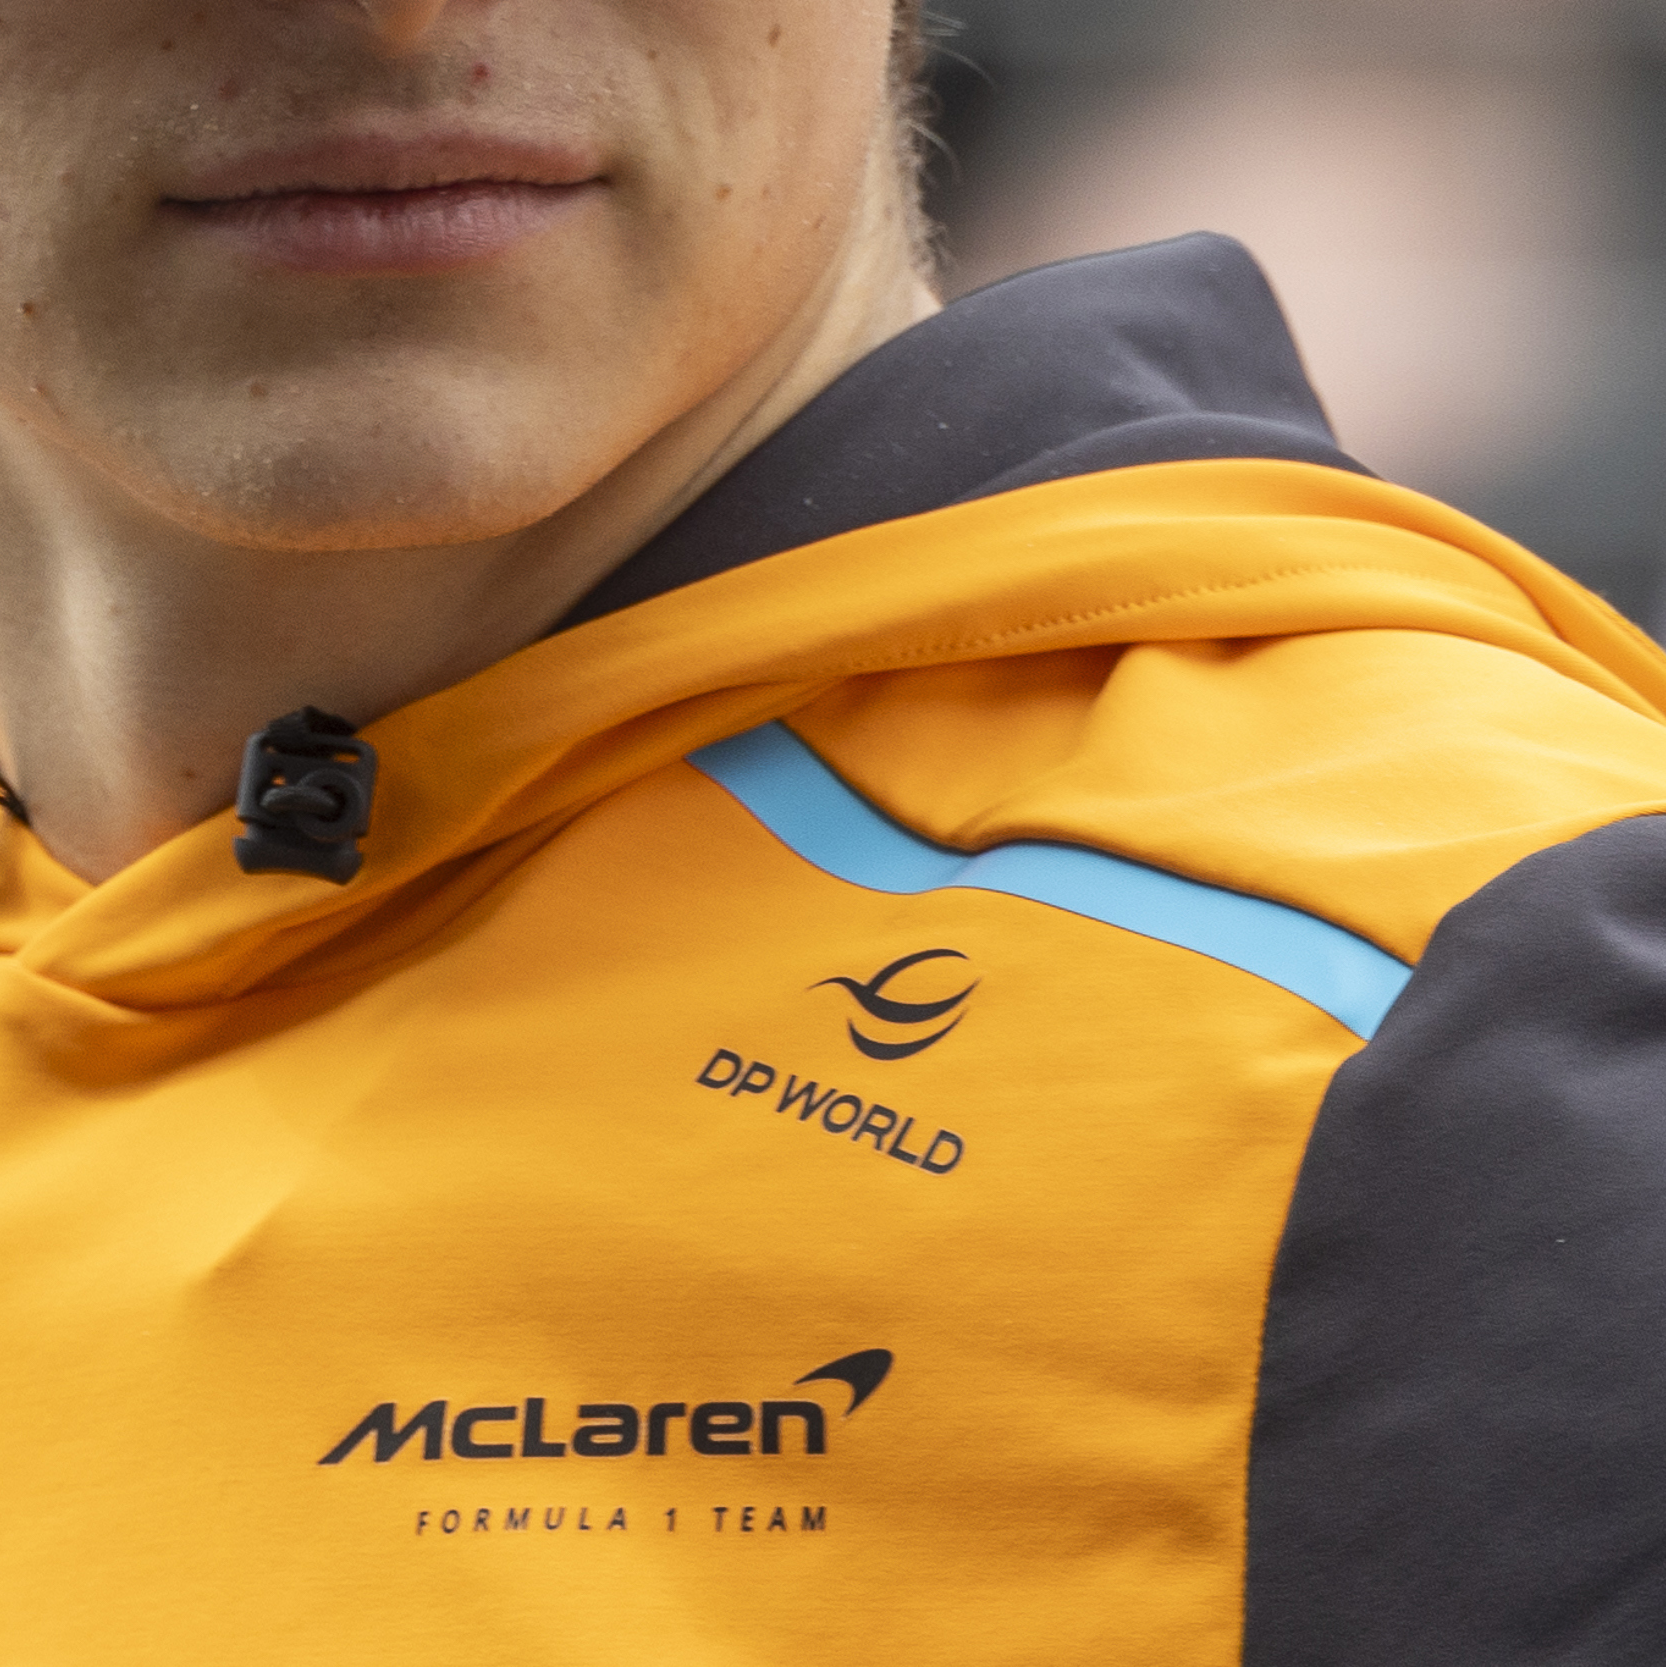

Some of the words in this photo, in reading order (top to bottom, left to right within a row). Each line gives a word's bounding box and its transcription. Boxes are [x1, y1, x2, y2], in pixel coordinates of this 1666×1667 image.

[696, 1048, 776, 1097] DP
[775, 1074, 964, 1174] WORLD
[317, 1398, 827, 1465] McLaren
[415, 1508, 630, 1536] FORMULA
[664, 1507, 678, 1534] 1
[713, 1507, 827, 1534] TEAM
